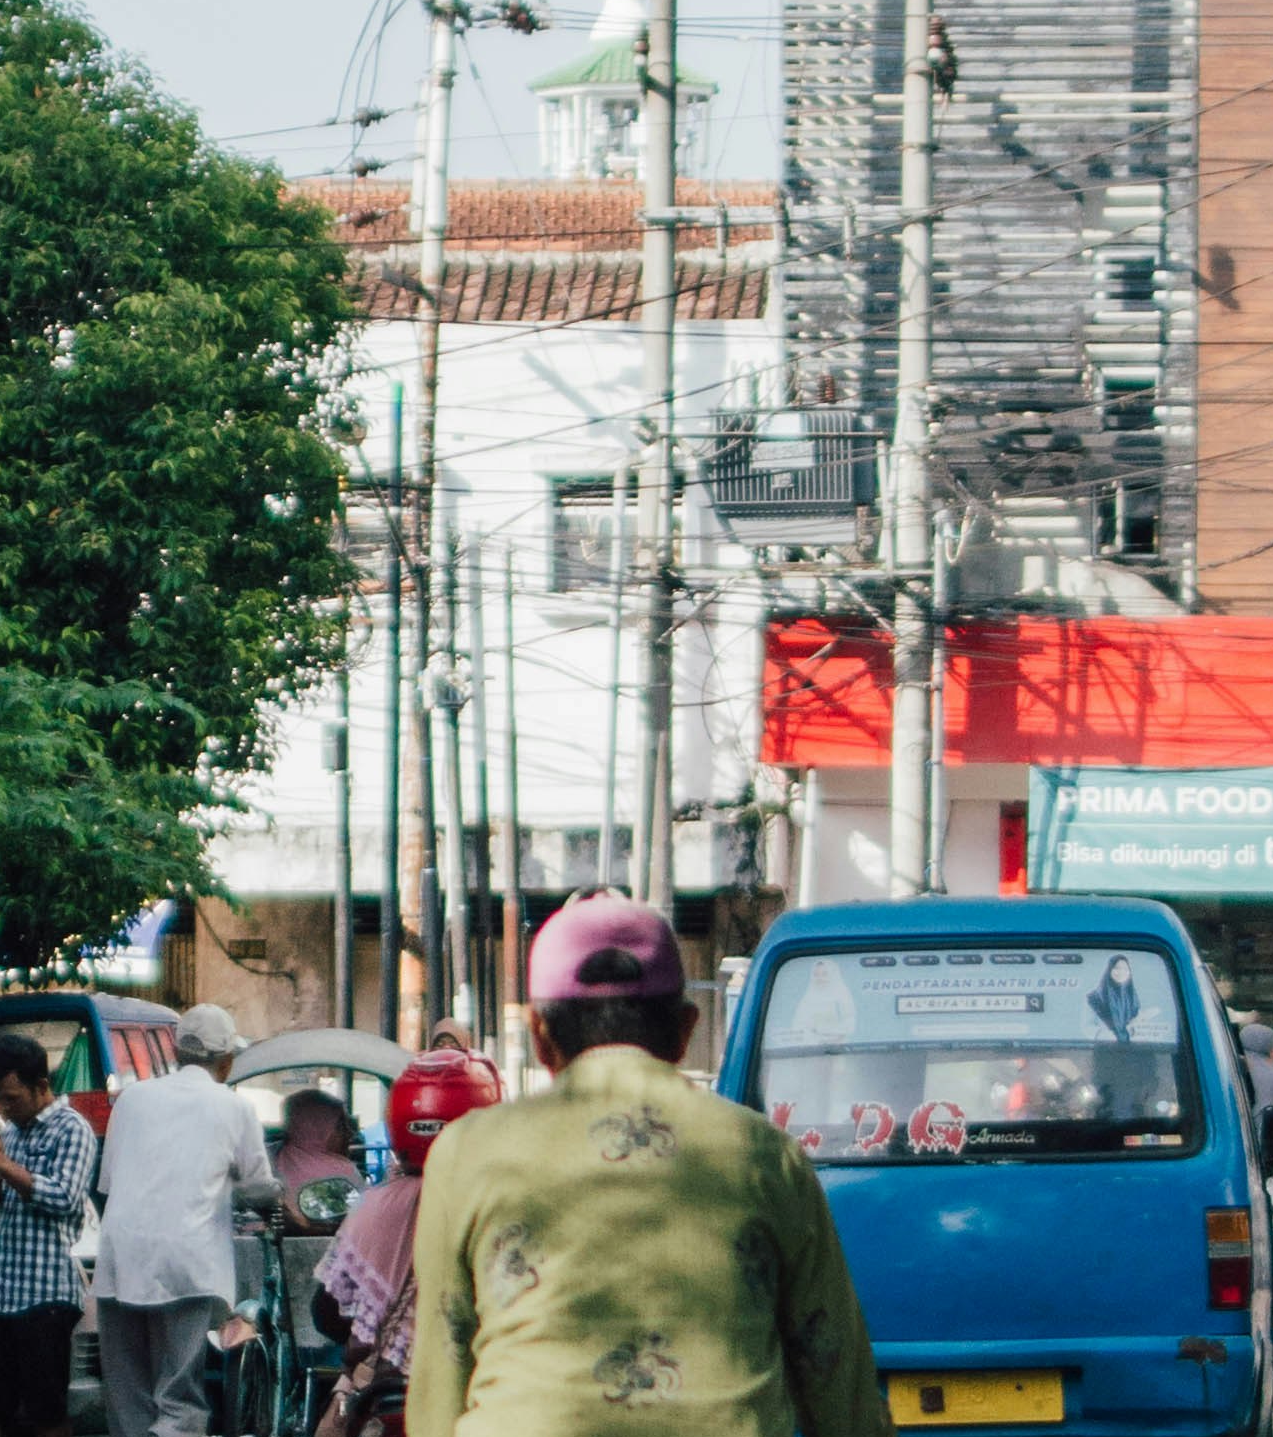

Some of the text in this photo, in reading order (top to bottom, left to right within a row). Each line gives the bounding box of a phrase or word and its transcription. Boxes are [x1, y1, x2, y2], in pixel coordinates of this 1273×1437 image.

[1057, 787, 1169, 813] PRIMA
[1177, 786, 1273, 814] FOOD
[1057, 842, 1104, 863] Bisa
[1110, 843, 1230, 868] dikunjungi
[1234, 844, 1256, 864] di
[977, 978, 1031, 988] SANTRI
[1037, 978, 1079, 988] BARU
